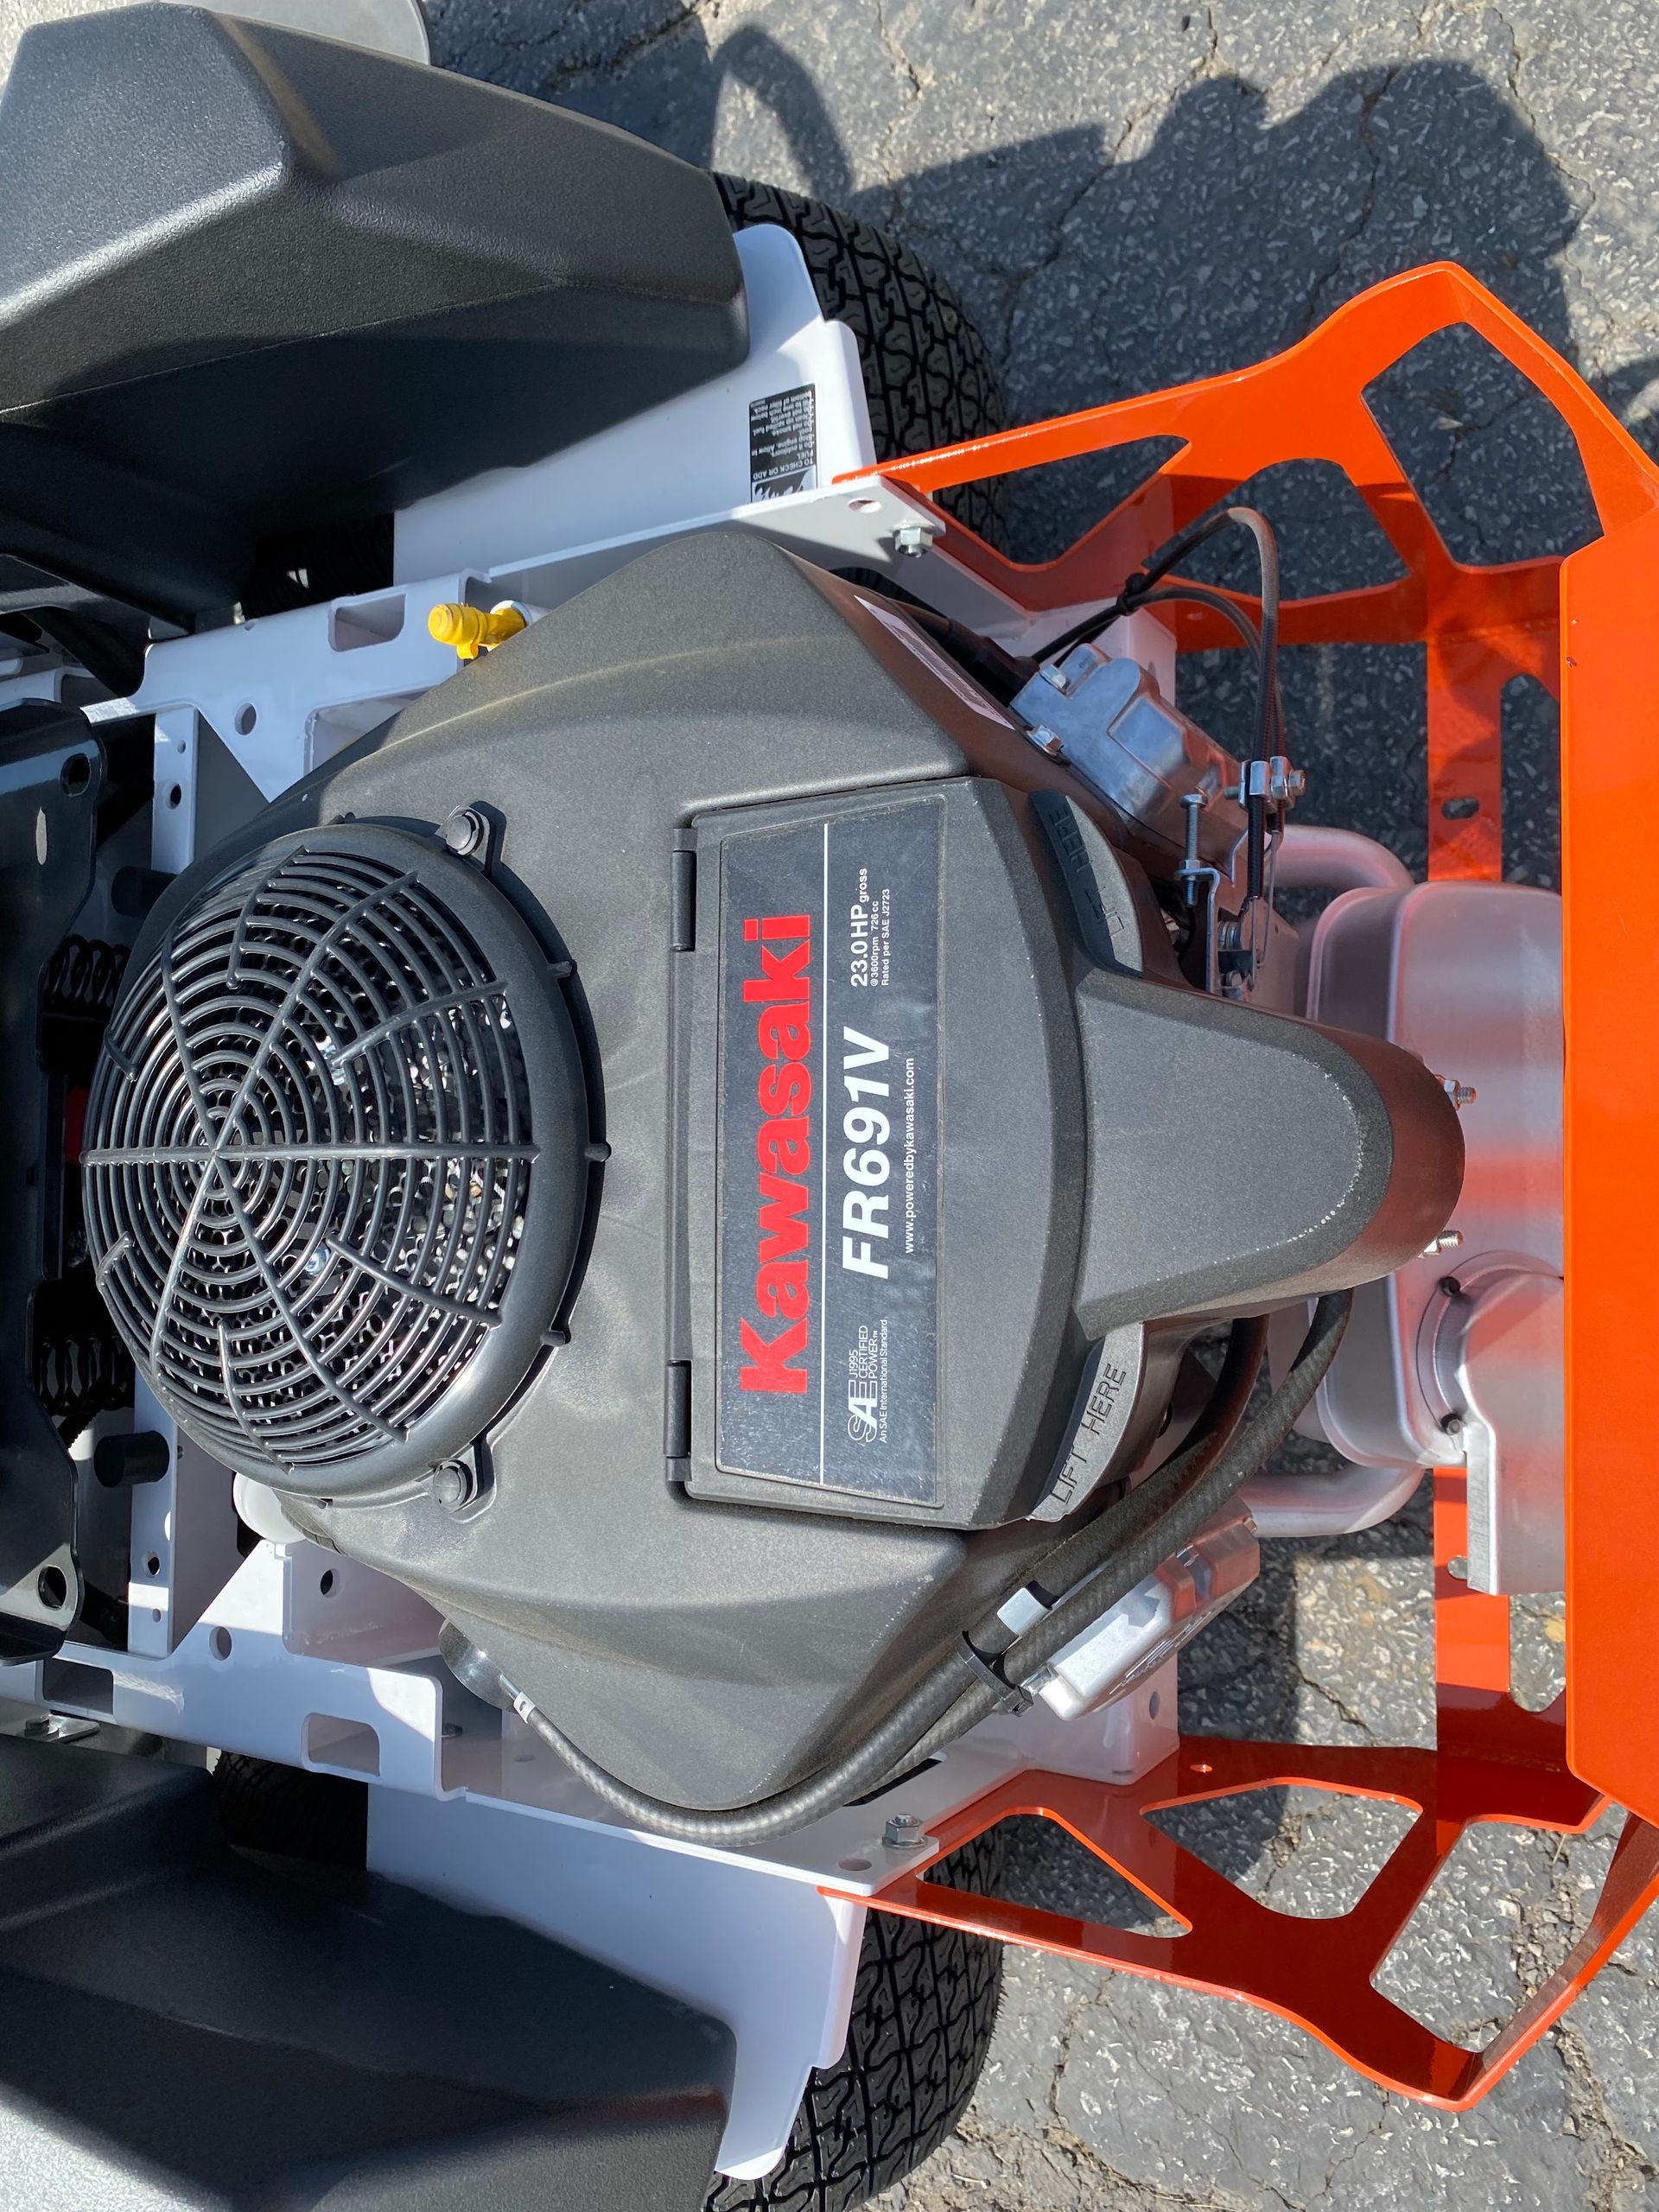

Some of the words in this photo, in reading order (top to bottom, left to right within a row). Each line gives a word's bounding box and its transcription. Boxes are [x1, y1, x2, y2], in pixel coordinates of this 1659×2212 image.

[780, 461, 803, 472] CHECK
[797, 449, 813, 460] FUEL
[753, 470, 767, 480] ADD
[859, 868, 869, 903] gross
[881, 888, 890, 916] J2723
[881, 918, 890, 938] SAE
[870, 936, 880, 987] @3600rpm
[740, 914, 812, 1395] Kawasaki
[842, 1026, 891, 1280] FR691V
[903, 1058, 917, 1254] www.poweredbykawasaki.com
[858, 1325, 868, 1379] CERTIFIED
[879, 1319, 888, 1357] Standard
[849, 1349, 858, 1378] J1995
[879, 1358, 888, 1409] International
[848, 1379, 878, 1443] SAE
[879, 1411, 888, 1430] SAE
[879, 1430, 887, 1443] An
[1050, 1444, 1087, 1506] LIFT
[1080, 1363, 1127, 1436] HERE
